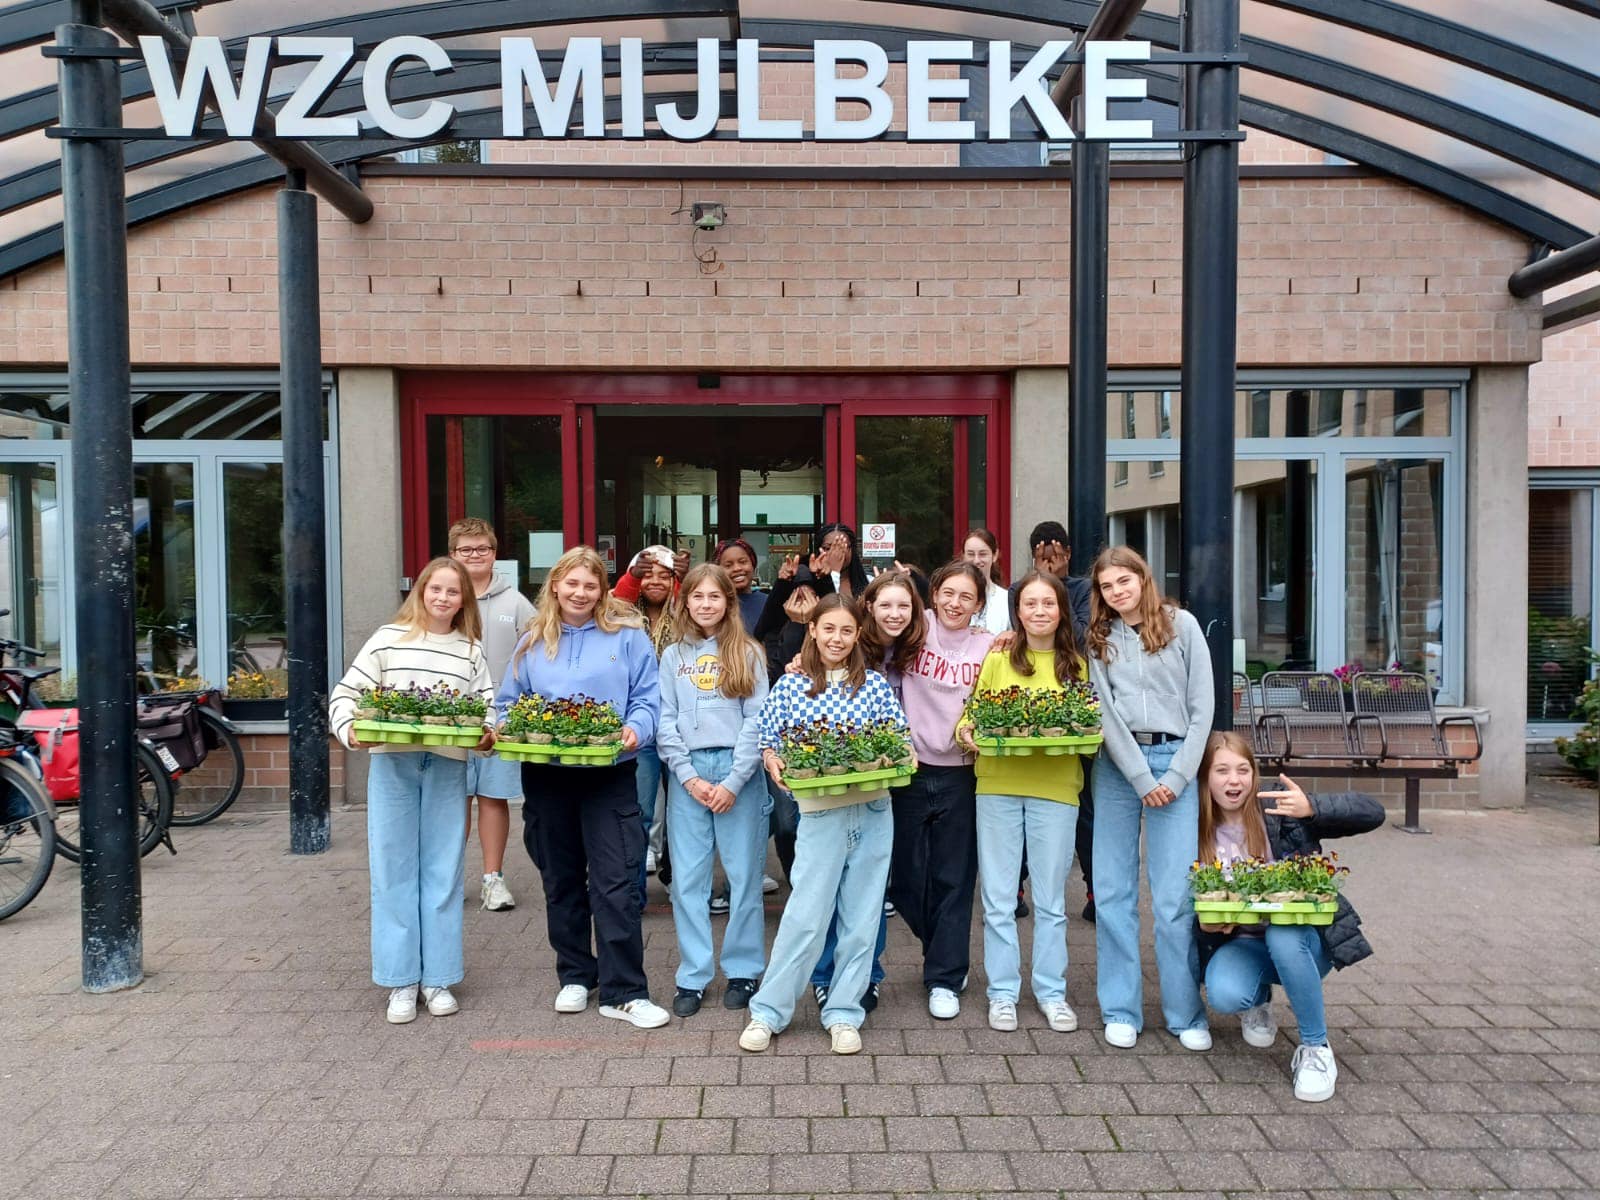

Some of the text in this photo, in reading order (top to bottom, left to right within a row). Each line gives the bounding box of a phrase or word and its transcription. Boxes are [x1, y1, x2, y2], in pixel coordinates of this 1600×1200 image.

[138, 35, 1153, 140] WZC MIJLBEKE
[912, 648, 981, 688] NEW YOR
